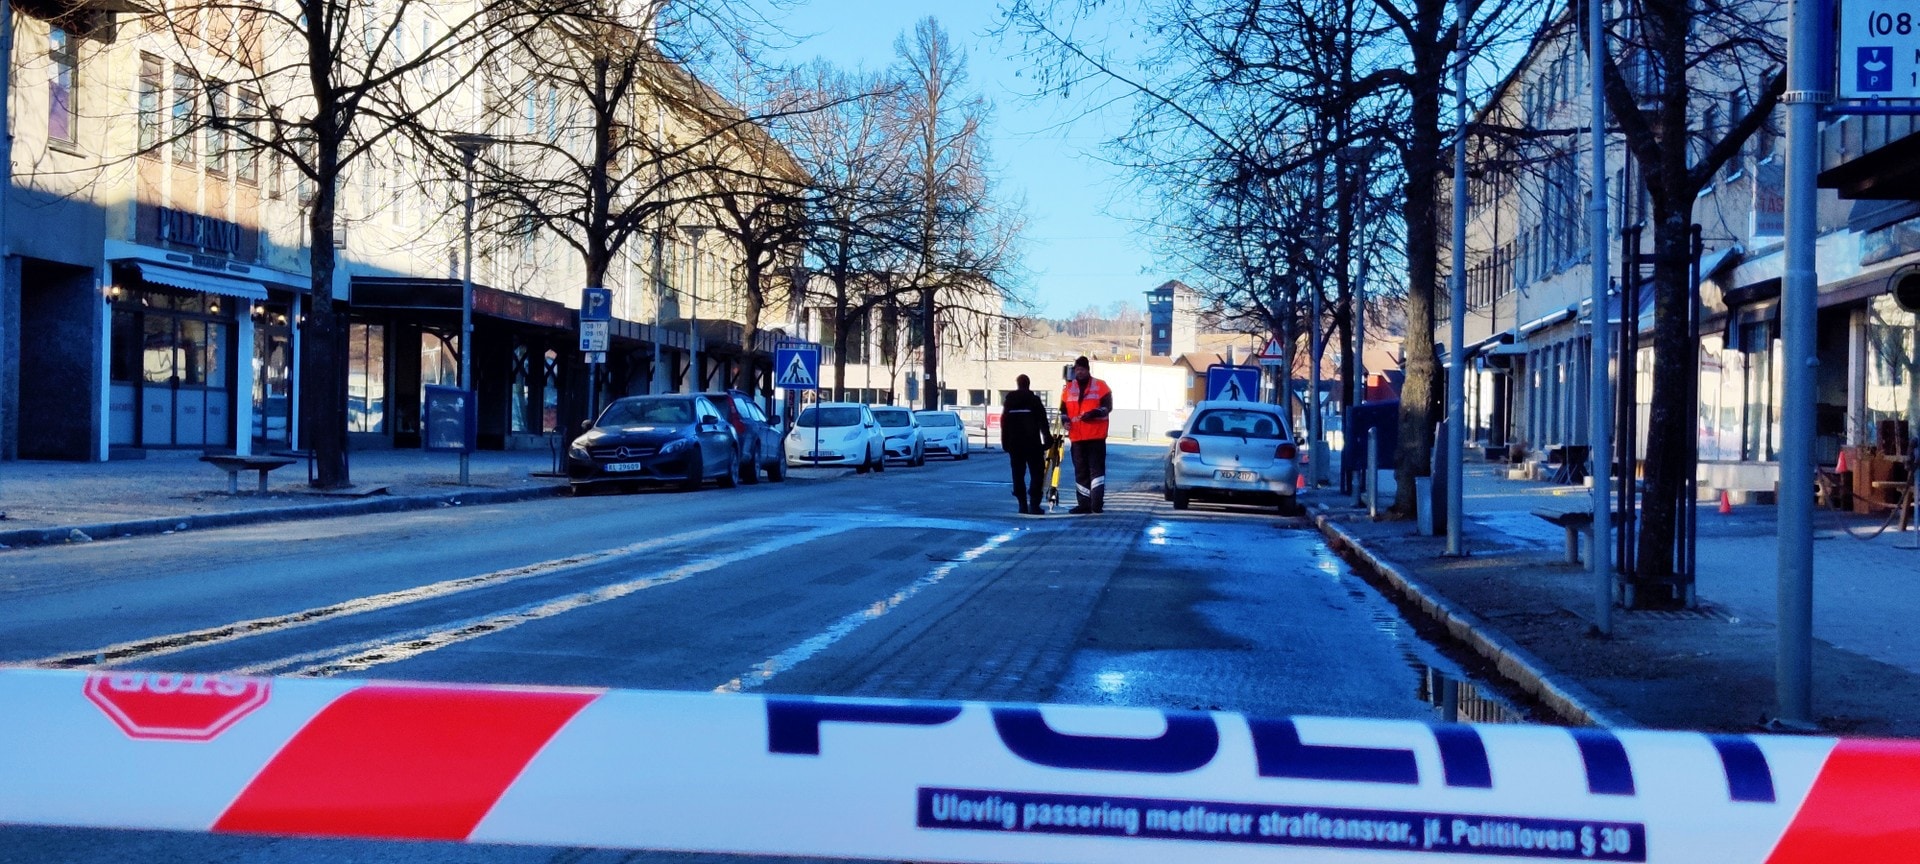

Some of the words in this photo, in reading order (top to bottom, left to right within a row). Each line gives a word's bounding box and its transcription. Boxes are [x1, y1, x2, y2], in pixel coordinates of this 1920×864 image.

[158, 205, 240, 257] PALERMO
[588, 292, 605, 316] P
[932, 793, 1017, 829] Ulovlig
[1023, 802, 1140, 836] passering
[1146, 805, 1252, 835] medfører
[1258, 811, 1417, 845] straffeansvar,
[1423, 817, 1447, 850] jf.
[1452, 819, 1576, 852] Politiloven
[1580, 825, 1596, 857] §
[1600, 828, 1631, 854] 30
